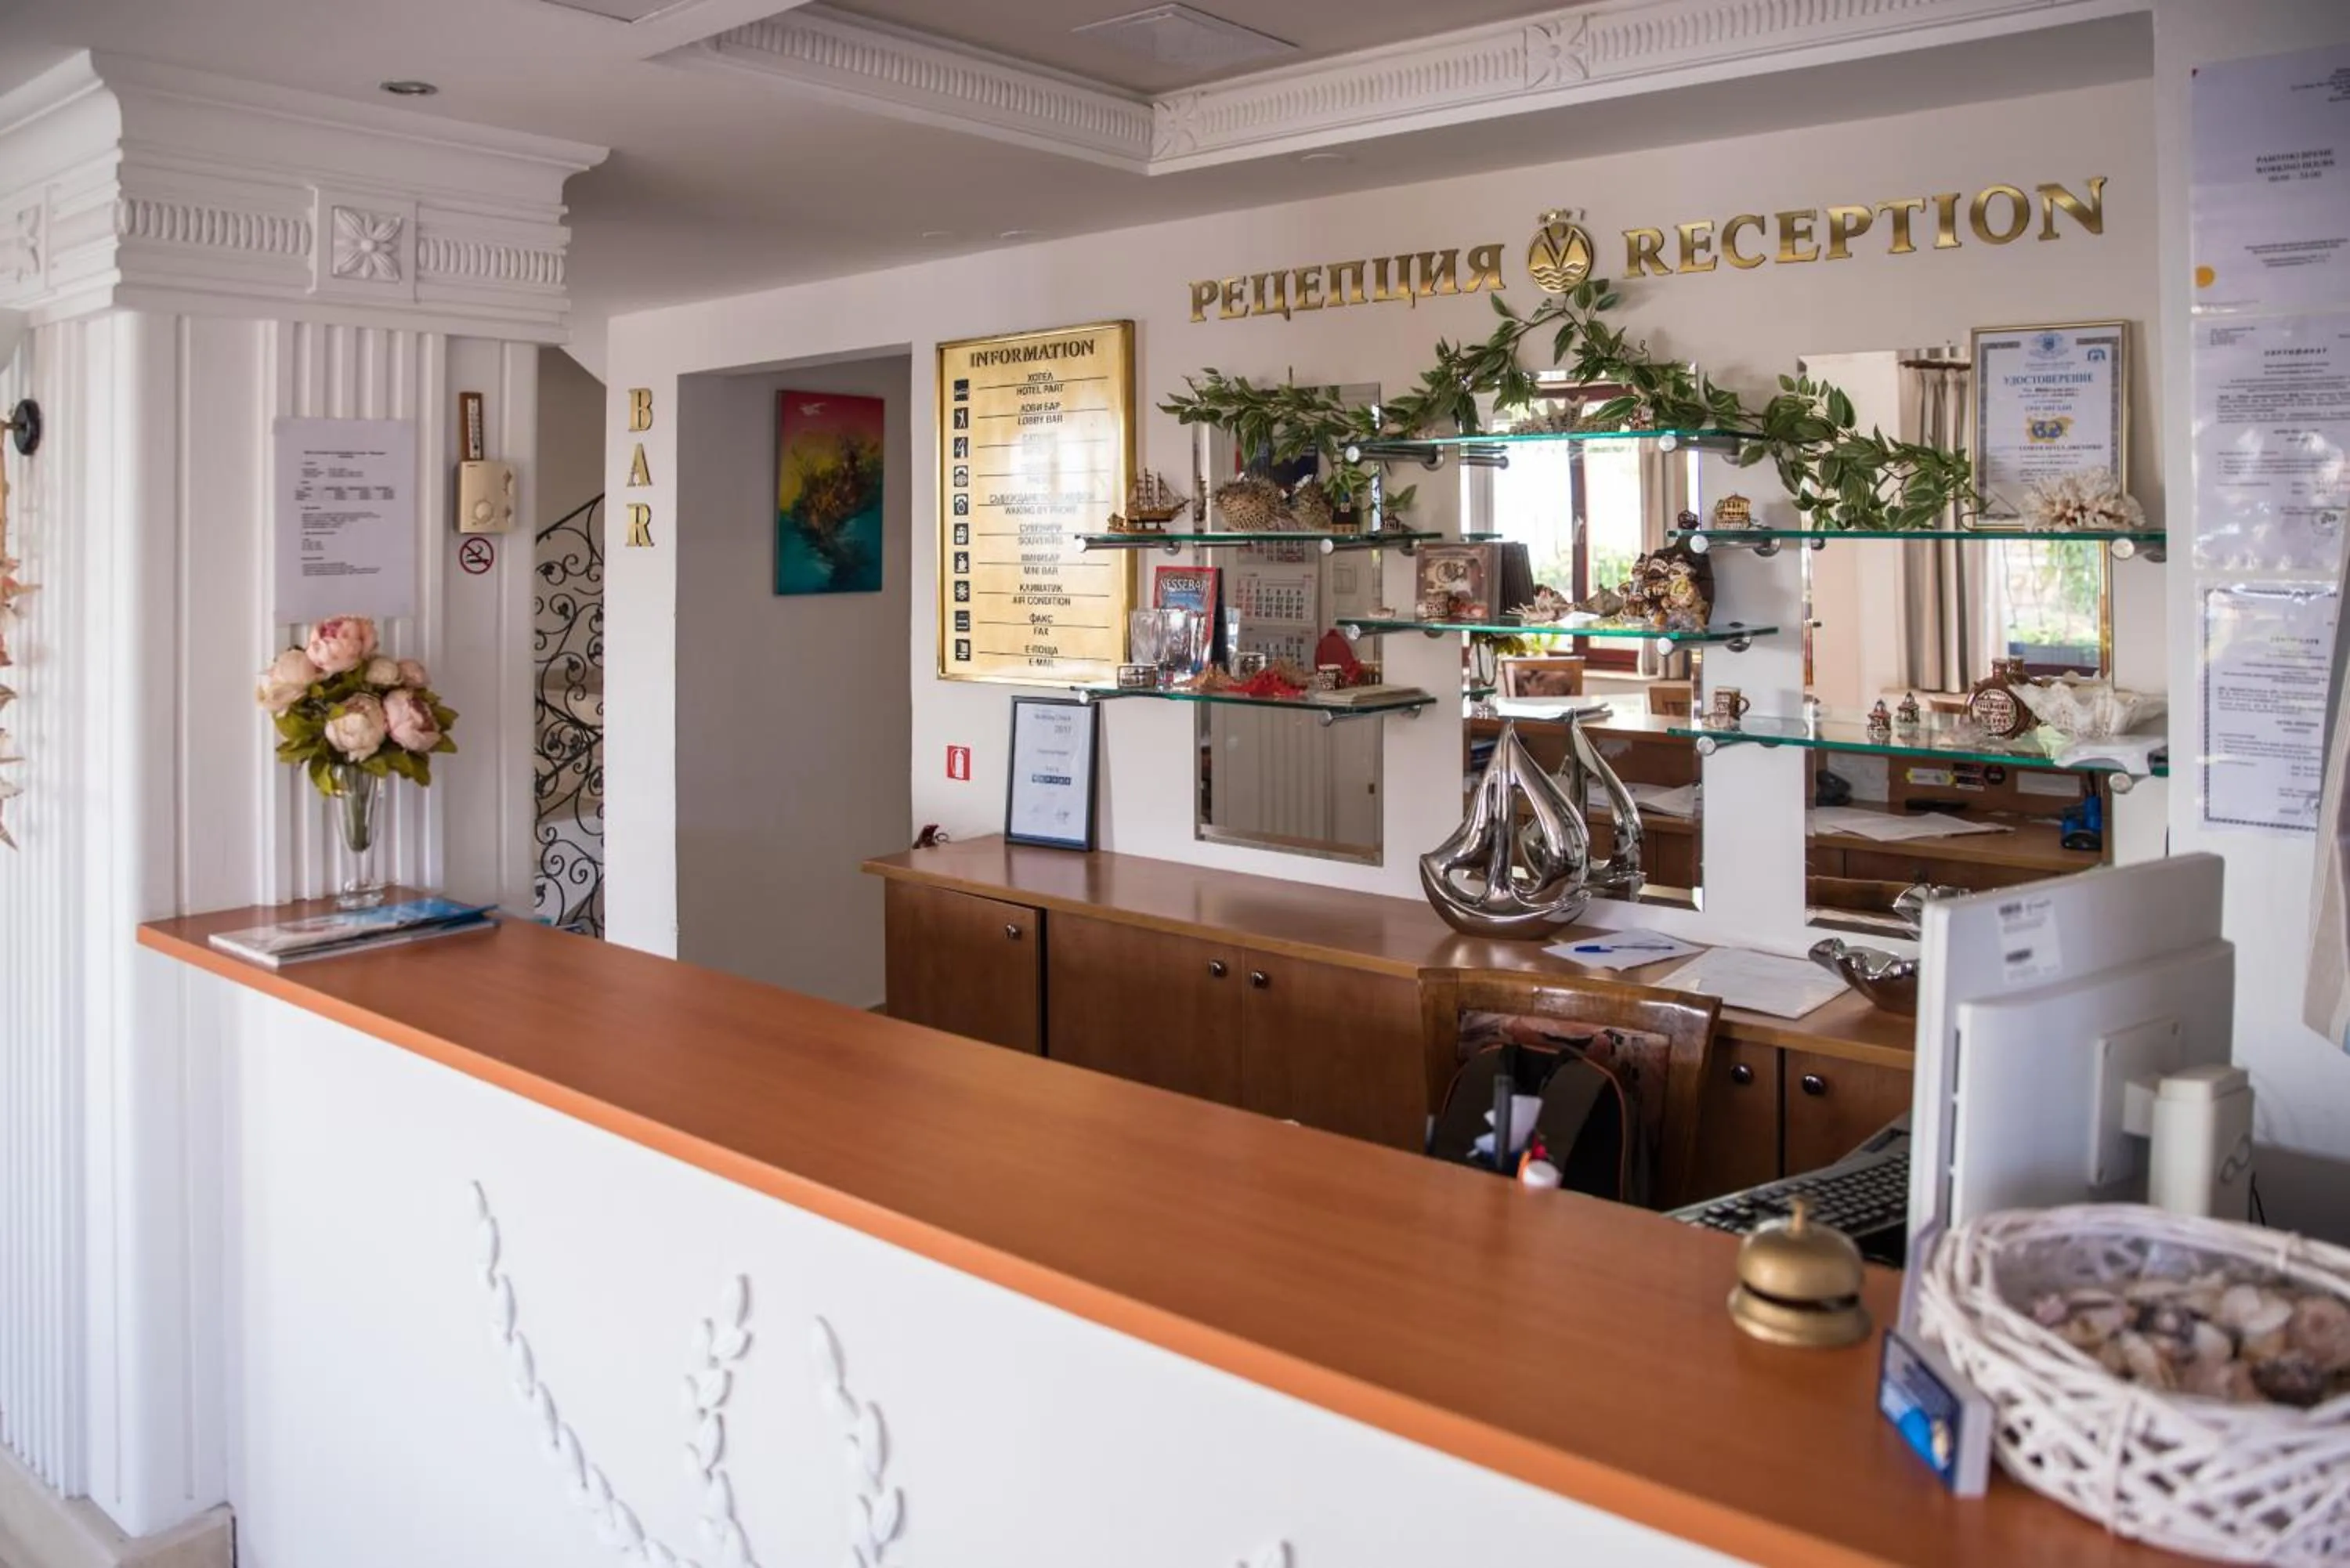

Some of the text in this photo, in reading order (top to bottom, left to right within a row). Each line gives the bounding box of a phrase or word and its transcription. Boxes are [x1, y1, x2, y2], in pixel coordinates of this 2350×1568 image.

[1622, 176, 2109, 280] RECEPTION
[1190, 242, 1506, 323] РЕЦЕПЦИЯ
[970, 338, 1095, 367] INFORMATION
[2003, 372, 2094, 387] УДОСТОВЕРЕНИЕ
[1017, 384, 1064, 396] HOTEL PART
[1044, 402, 1061, 411] БАР
[1018, 414, 1063, 426] LOBBY BAR
[625, 388, 655, 547] BAR
[1004, 505, 1036, 515] WAKING
[1041, 567, 1058, 576] BAR
[1027, 596, 1071, 605] CONDITION
[1029, 613, 1054, 624] ФАКС
[1033, 627, 1049, 636] FAX
[1029, 659, 1054, 668] E-MAIL
